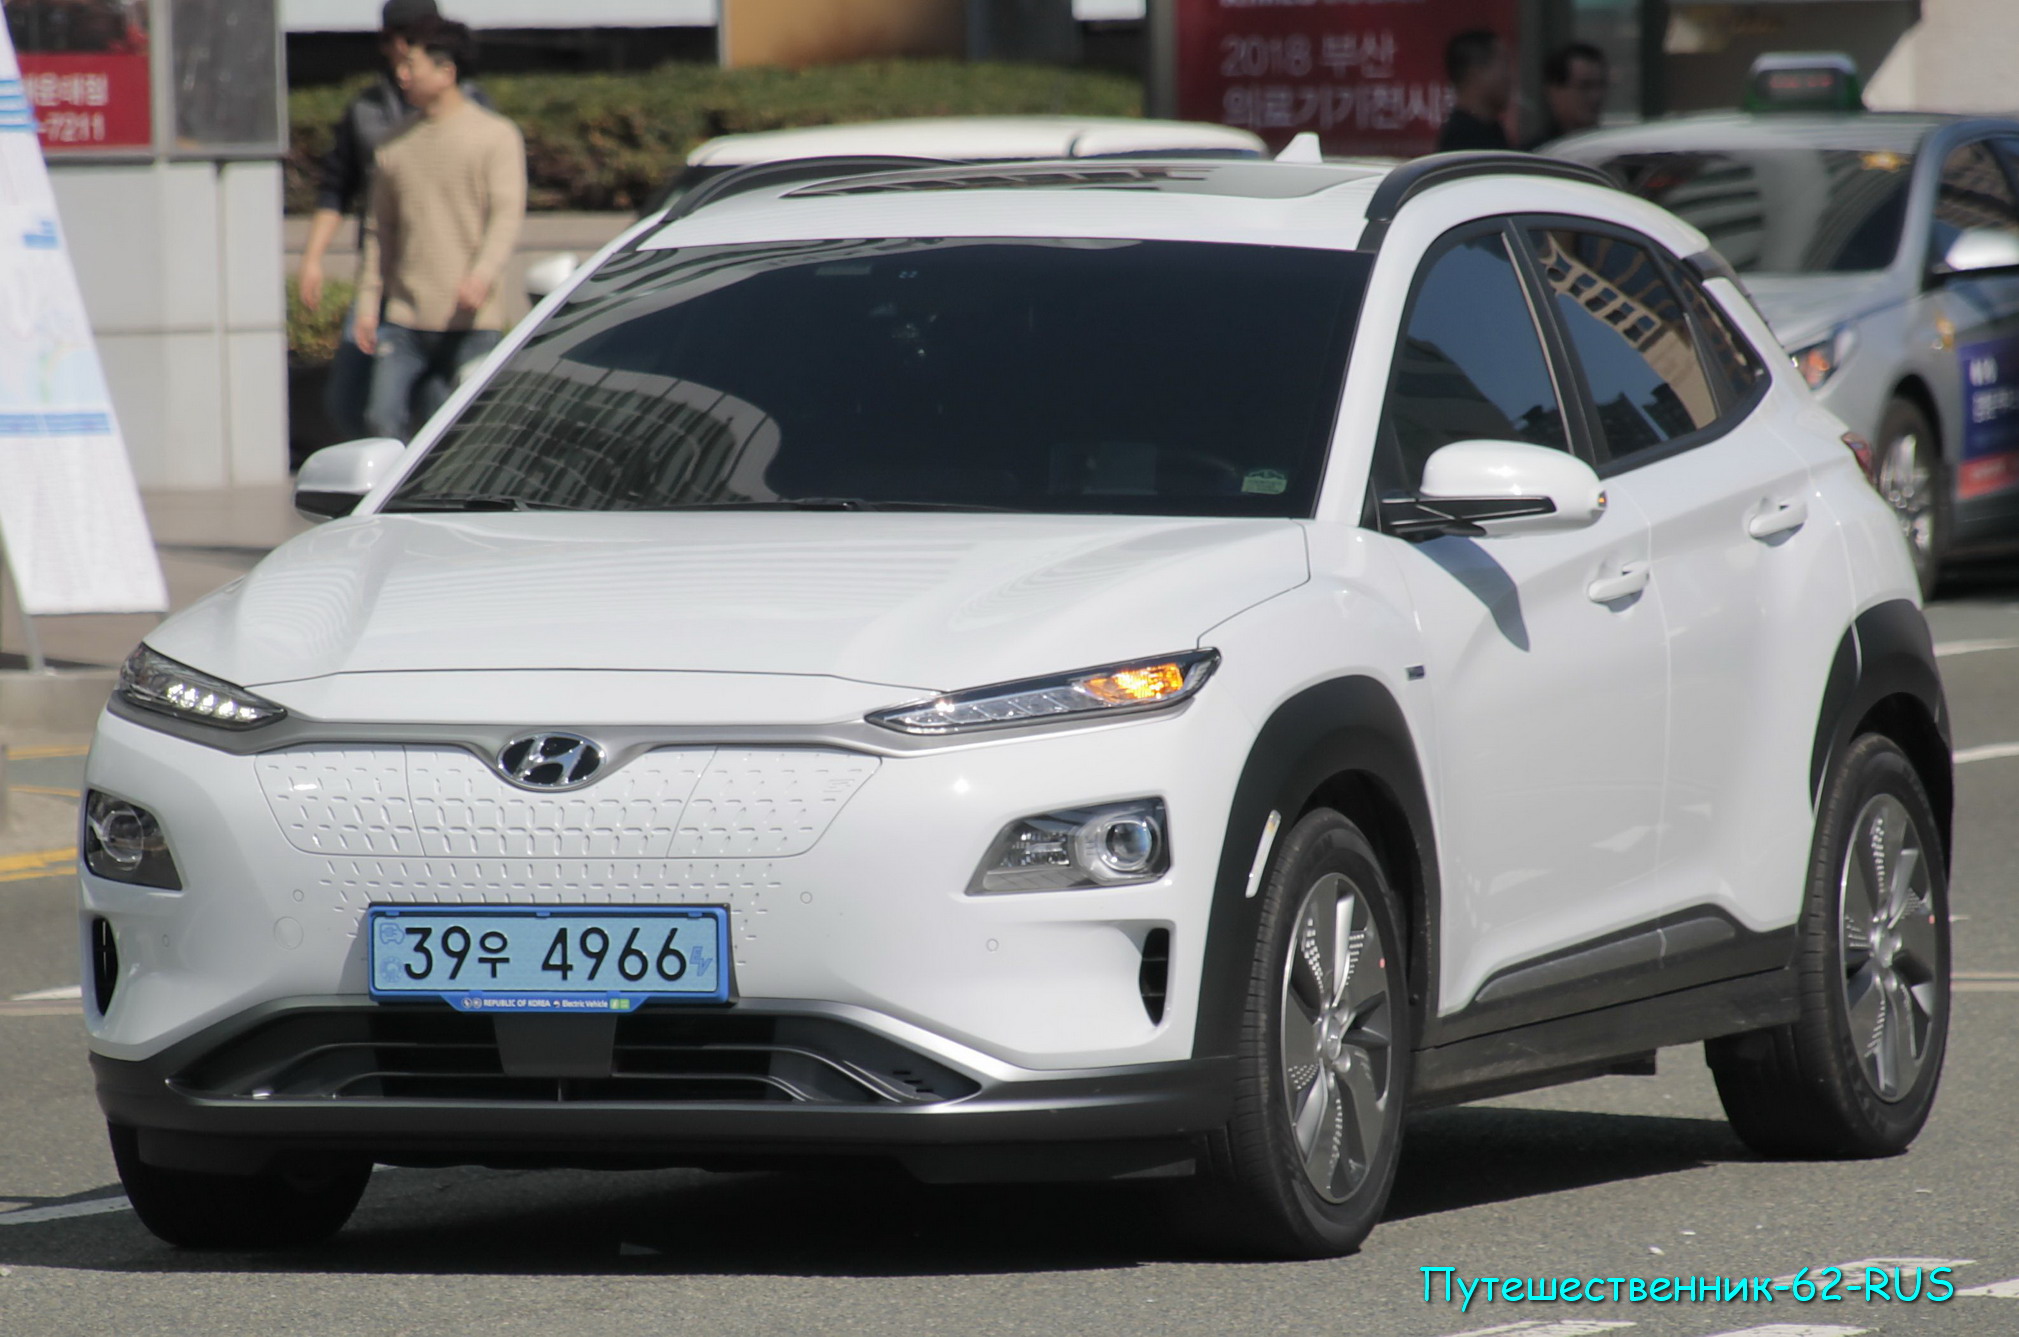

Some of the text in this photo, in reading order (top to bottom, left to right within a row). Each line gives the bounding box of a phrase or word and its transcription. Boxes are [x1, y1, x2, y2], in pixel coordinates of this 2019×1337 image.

[1221, 31, 1395, 78] 2018 부산
[404, 926, 687, 981] 39우 4966
[689, 945, 714, 977] EV
[483, 998, 515, 1008] REPUBLIC
[517, 998, 527, 1008] OF
[528, 998, 551, 1008] KOREA
[562, 998, 584, 1009] Electric
[585, 999, 608, 1009] Vehicle
